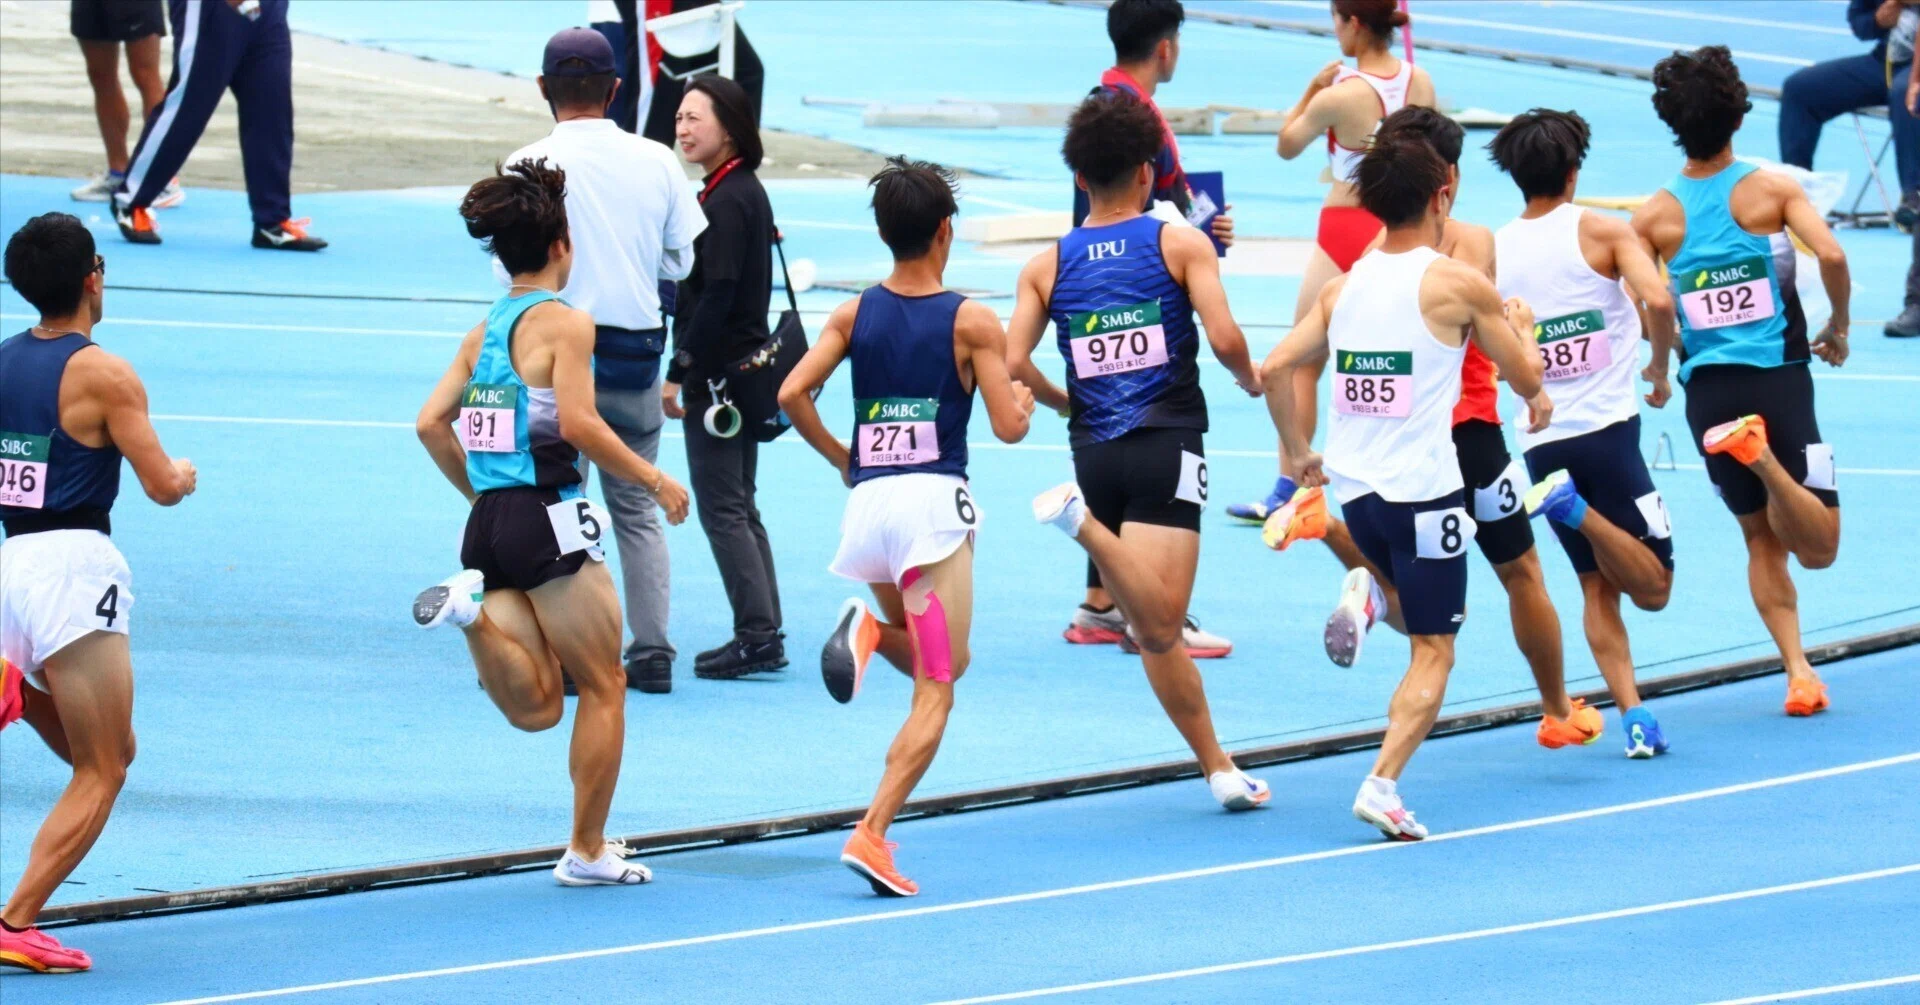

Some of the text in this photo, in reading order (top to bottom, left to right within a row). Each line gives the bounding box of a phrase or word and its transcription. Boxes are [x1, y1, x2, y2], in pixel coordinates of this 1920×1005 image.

[1087, 239, 1126, 261] IPU
[1711, 264, 1750, 285] SMBC
[1700, 286, 1755, 315] 192
[1101, 309, 1144, 328] SMBC
[1545, 316, 1588, 338] SMBC
[1088, 331, 1148, 363] 970
[1355, 356, 1395, 370] SMBC
[1345, 378, 1395, 403] 885
[881, 403, 920, 418] SMBC
[467, 411, 496, 438] 191
[870, 425, 917, 452] 271
[1197, 462, 1207, 501] 9
[955, 486, 976, 525] 6
[1498, 478, 1517, 513] 3
[576, 501, 601, 541] 5
[1441, 513, 1462, 554] 8
[95, 583, 118, 628] 4
